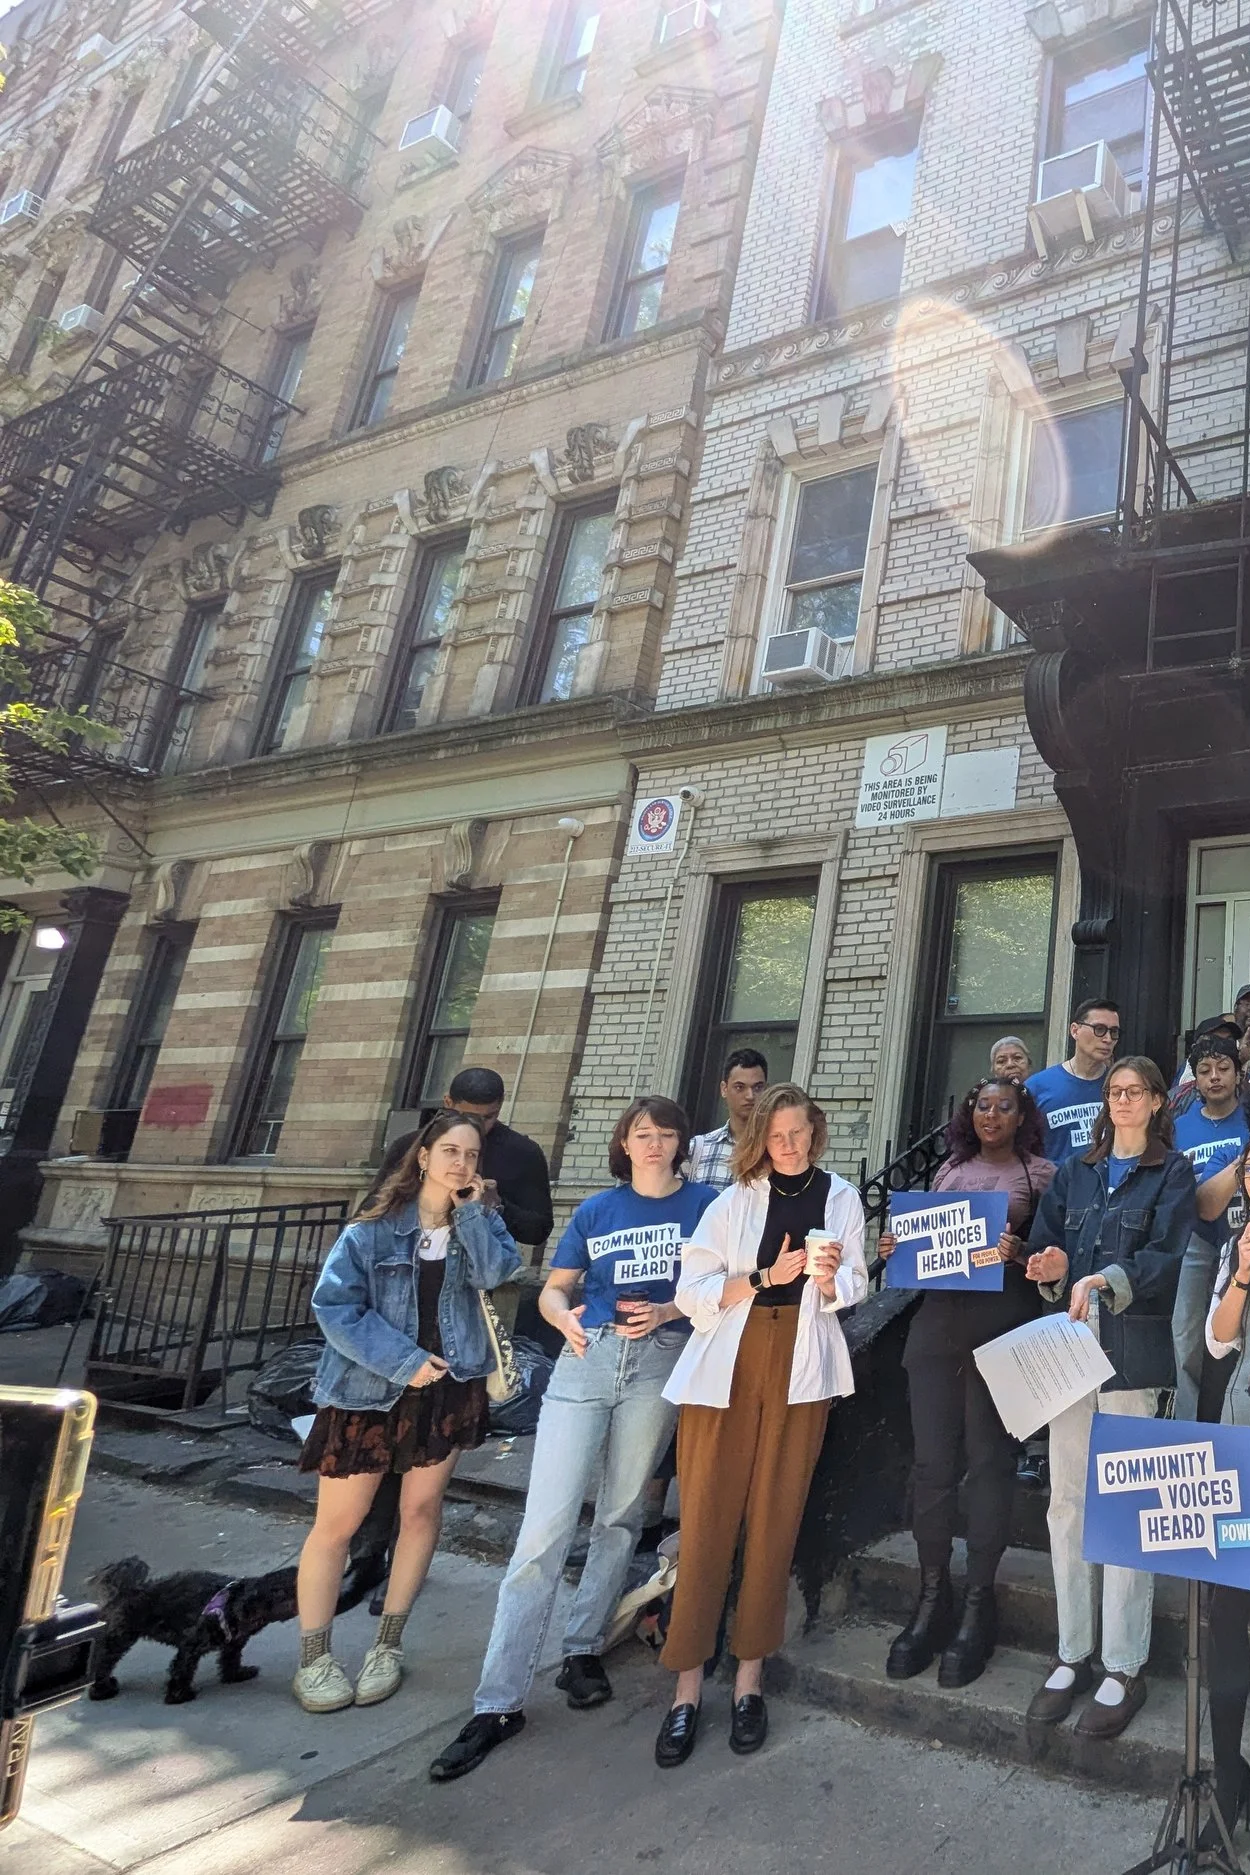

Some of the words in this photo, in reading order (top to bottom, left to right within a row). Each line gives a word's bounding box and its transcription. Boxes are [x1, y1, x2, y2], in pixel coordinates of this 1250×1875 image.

[864, 782, 881, 792] THIS
[882, 778, 903, 790] AREA
[905, 777, 913, 787] IS
[915, 773, 938, 786] BEING
[870, 787, 916, 802] MONITORED
[917, 785, 928, 796] BY
[860, 801, 881, 813] VIDEO
[883, 794, 937, 811] SURVEILLANCE
[878, 811, 888, 821] 24
[890, 808, 916, 820] HOURS
[1051, 1105, 1101, 1125] COMMUNITY
[895, 1206, 966, 1238] COMMUNITY
[593, 1227, 675, 1255] COMMUNITY
[937, 1224, 982, 1249] VOICES
[641, 1241, 683, 1260] VOICE
[922, 1249, 963, 1273] HEARD
[620, 1259, 668, 1279] HEARD
[1104, 1450, 1208, 1486] COMMUNITY
[1167, 1478, 1233, 1510] VOICES
[1147, 1512, 1206, 1542] HEARD
